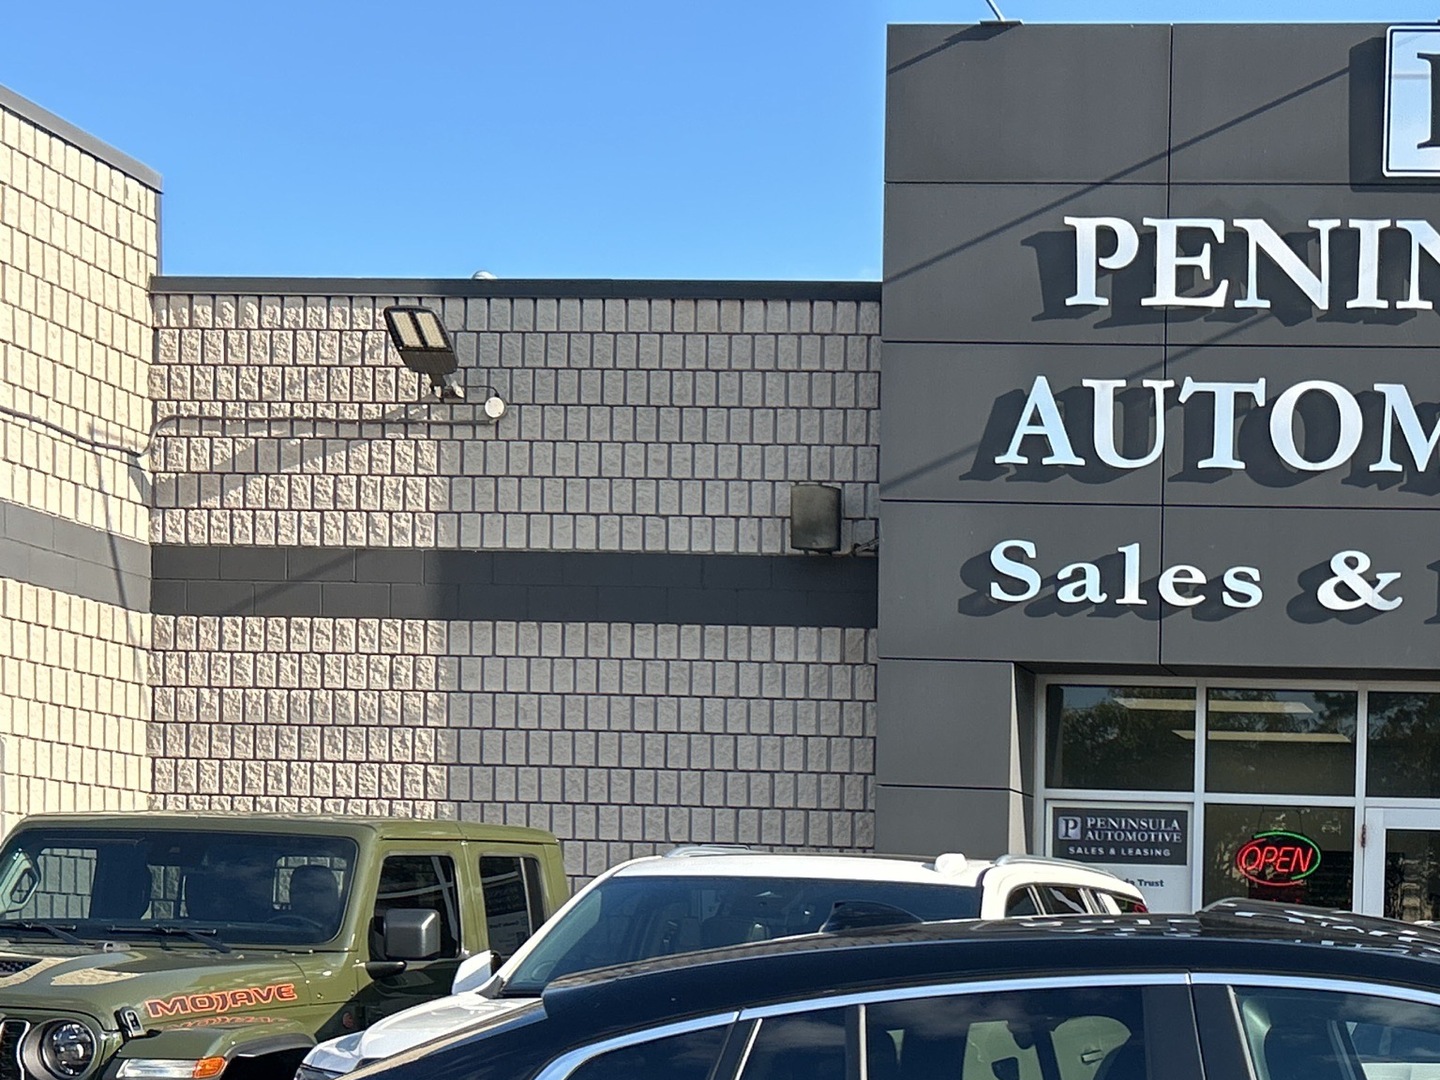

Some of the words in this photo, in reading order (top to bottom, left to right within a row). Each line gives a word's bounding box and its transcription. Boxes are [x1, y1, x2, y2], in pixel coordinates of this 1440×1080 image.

[990, 539, 1264, 608] Sales
[1317, 549, 1403, 611] &
[1062, 818, 1078, 838] P
[1085, 816, 1180, 831] PENINSULA
[1085, 830, 1182, 843] AUTOMOTIVE
[1068, 846, 1105, 855] SALES
[1109, 847, 1116, 855] &
[1121, 847, 1171, 857] LEASING
[1241, 846, 1313, 873] OPEN
[1137, 878, 1165, 887] Trust
[145, 983, 298, 1018] MOJAVE
